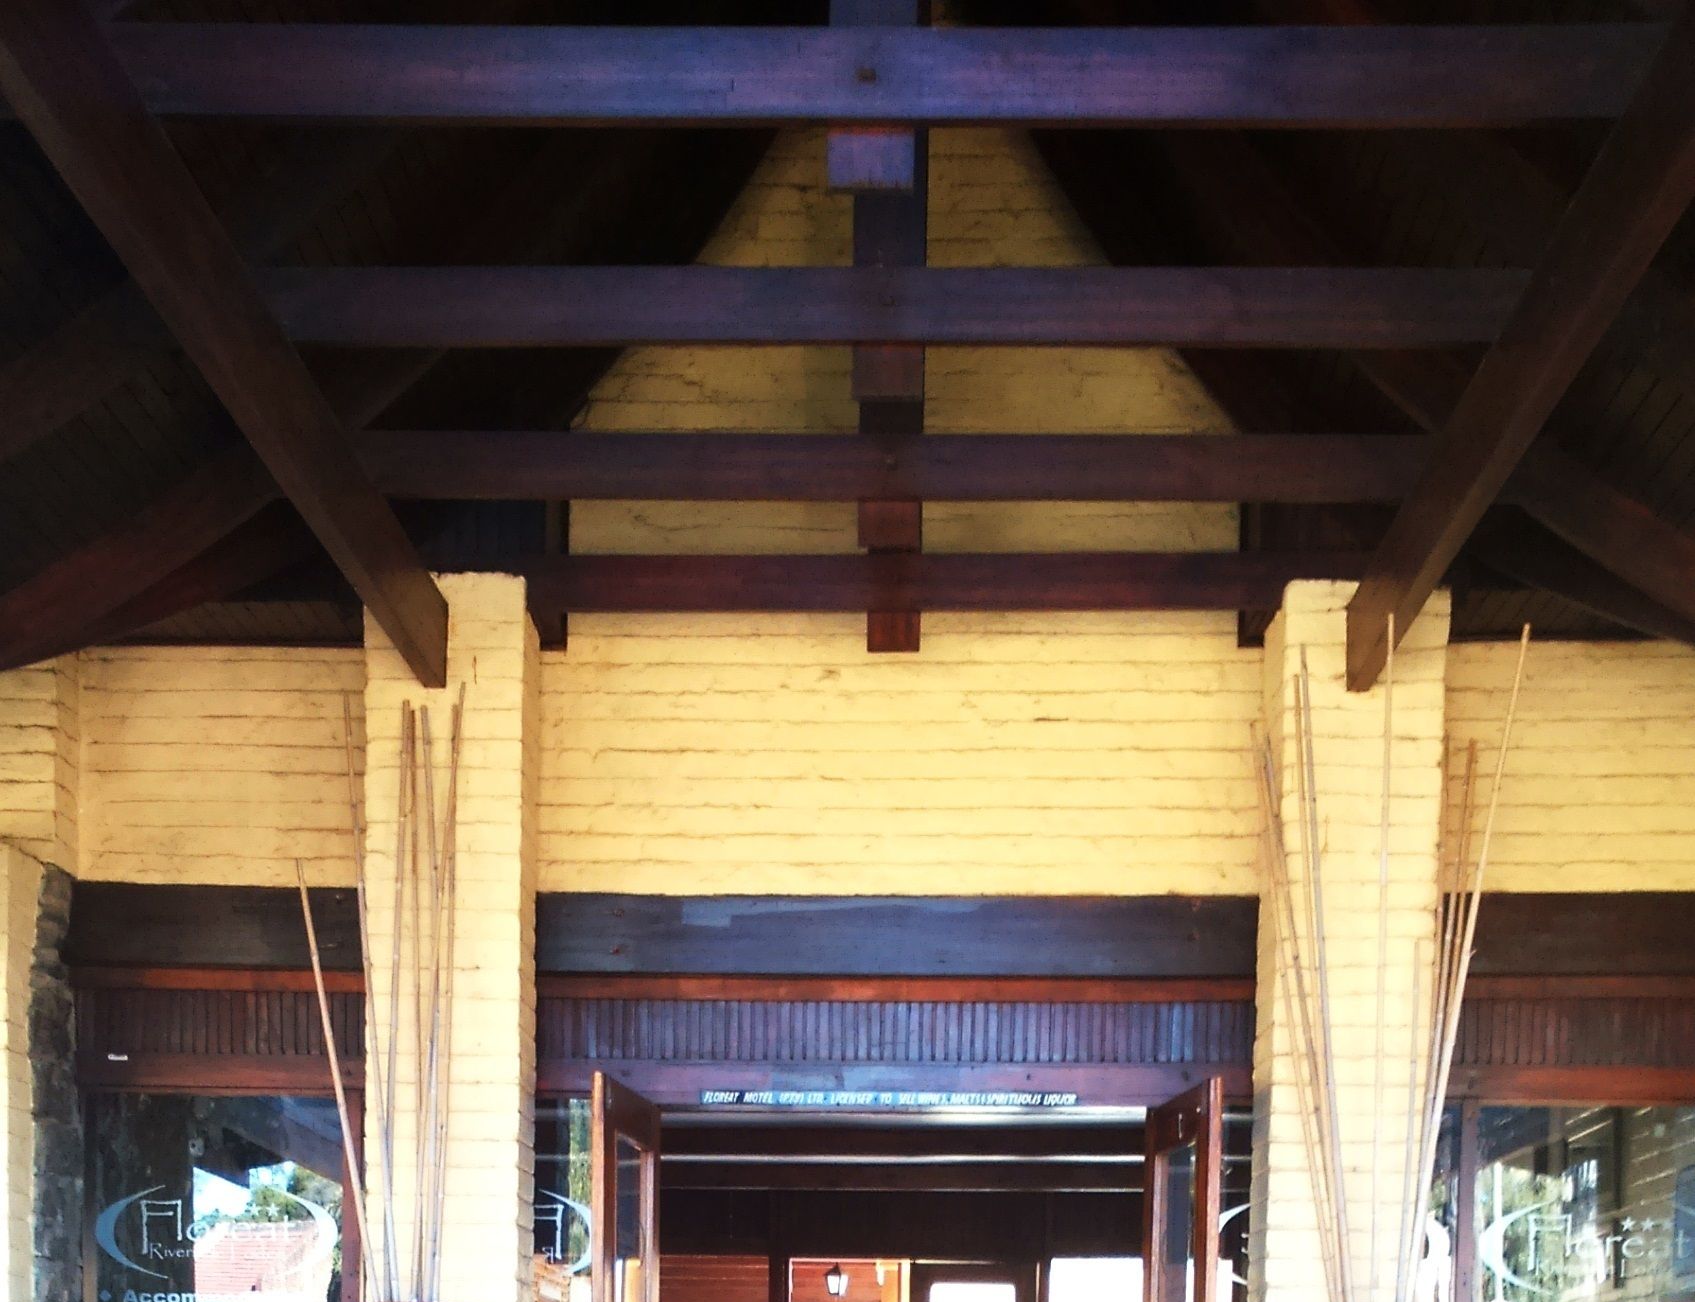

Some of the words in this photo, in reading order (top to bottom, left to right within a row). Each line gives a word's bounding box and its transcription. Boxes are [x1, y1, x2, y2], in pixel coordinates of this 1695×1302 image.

[703, 1091, 740, 1104] FLOREAT
[743, 1092, 773, 1104] MOTEL
[880, 1091, 893, 1105] TO
[899, 1091, 915, 1105] SELL
[1044, 1093, 1077, 1108] LIQUOR
